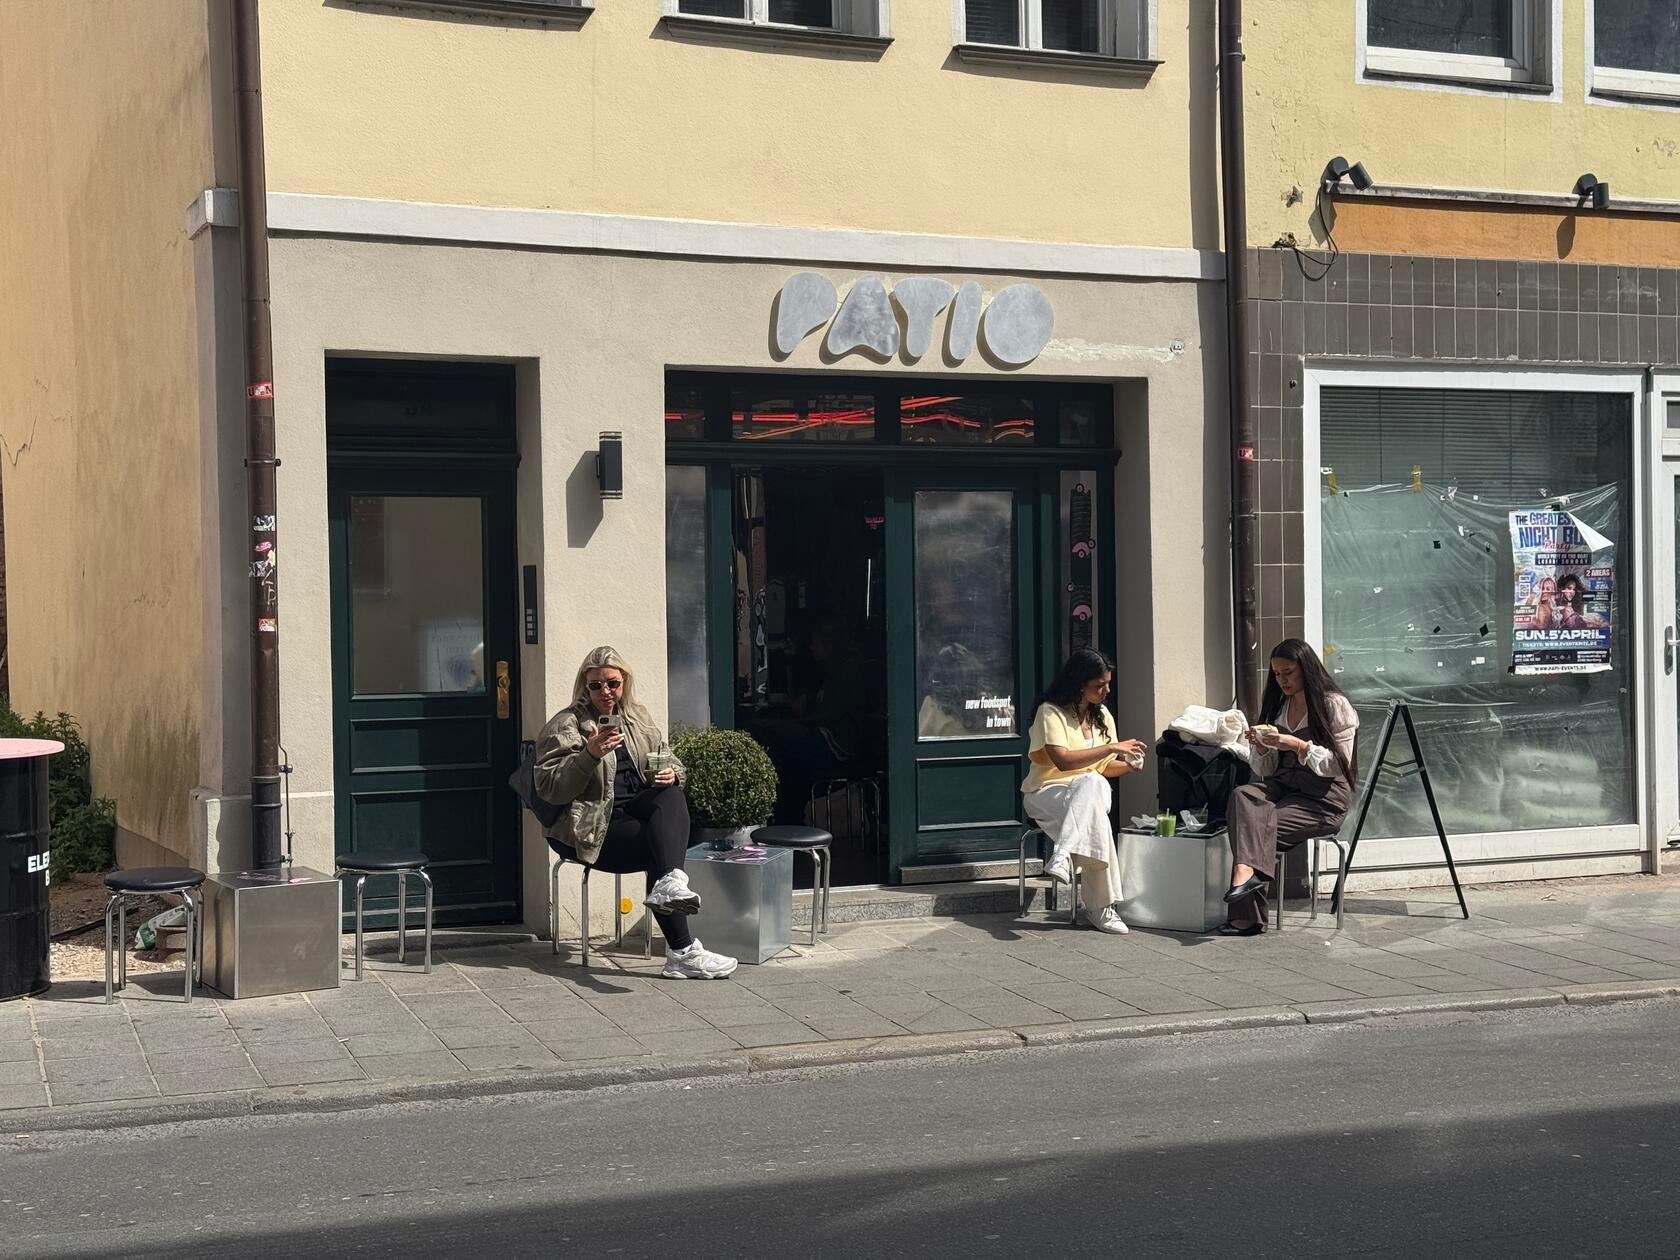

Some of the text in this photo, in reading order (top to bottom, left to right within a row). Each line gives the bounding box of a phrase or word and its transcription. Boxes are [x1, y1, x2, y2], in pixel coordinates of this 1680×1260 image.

[777, 272, 1055, 364] PATIO
[1515, 515, 1529, 526] THE
[1518, 526, 1558, 549] NIGHT
[1591, 569, 1610, 577] AREAS
[965, 696, 1011, 710] new foodspot
[986, 715, 1011, 727] in town
